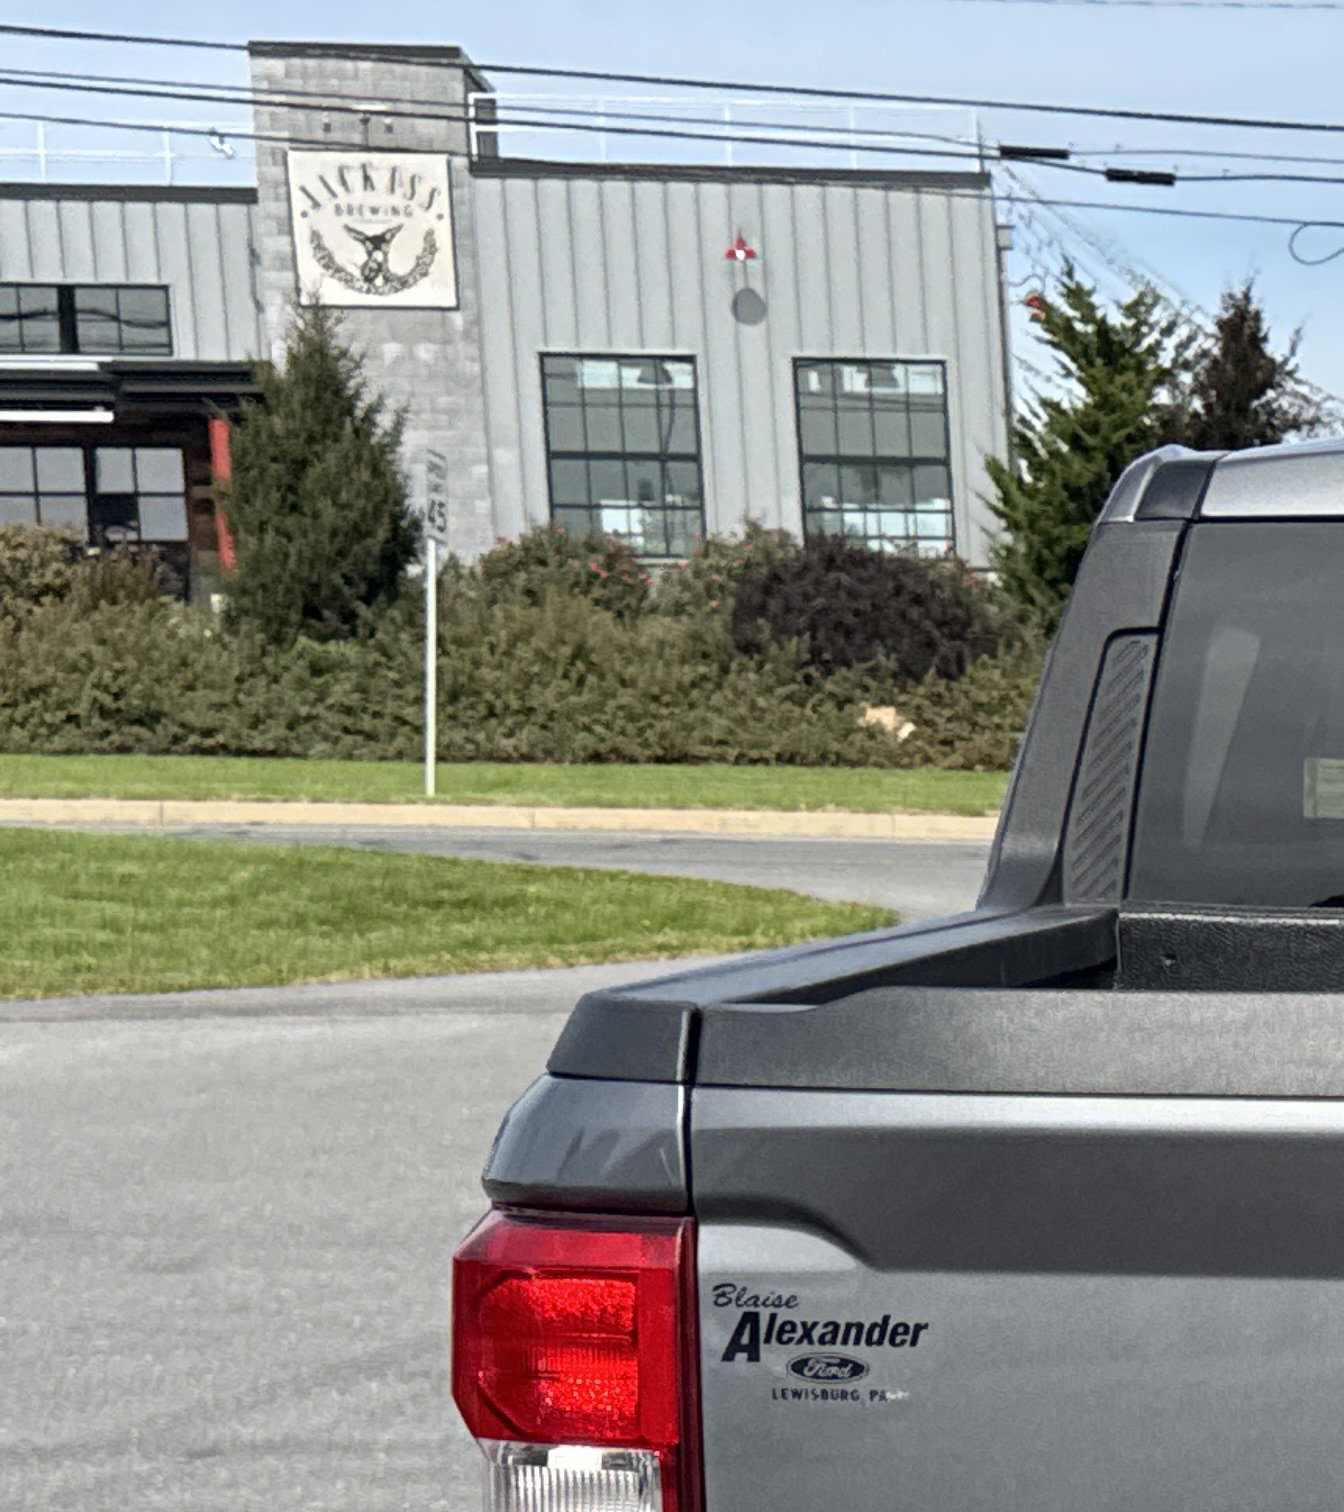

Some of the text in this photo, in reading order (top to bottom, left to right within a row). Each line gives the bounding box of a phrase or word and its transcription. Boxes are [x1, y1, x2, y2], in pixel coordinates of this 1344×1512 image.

[712, 1283, 800, 1309] Blaise
[720, 1311, 930, 1363] Alexander
[803, 1357, 854, 1379] Ford
